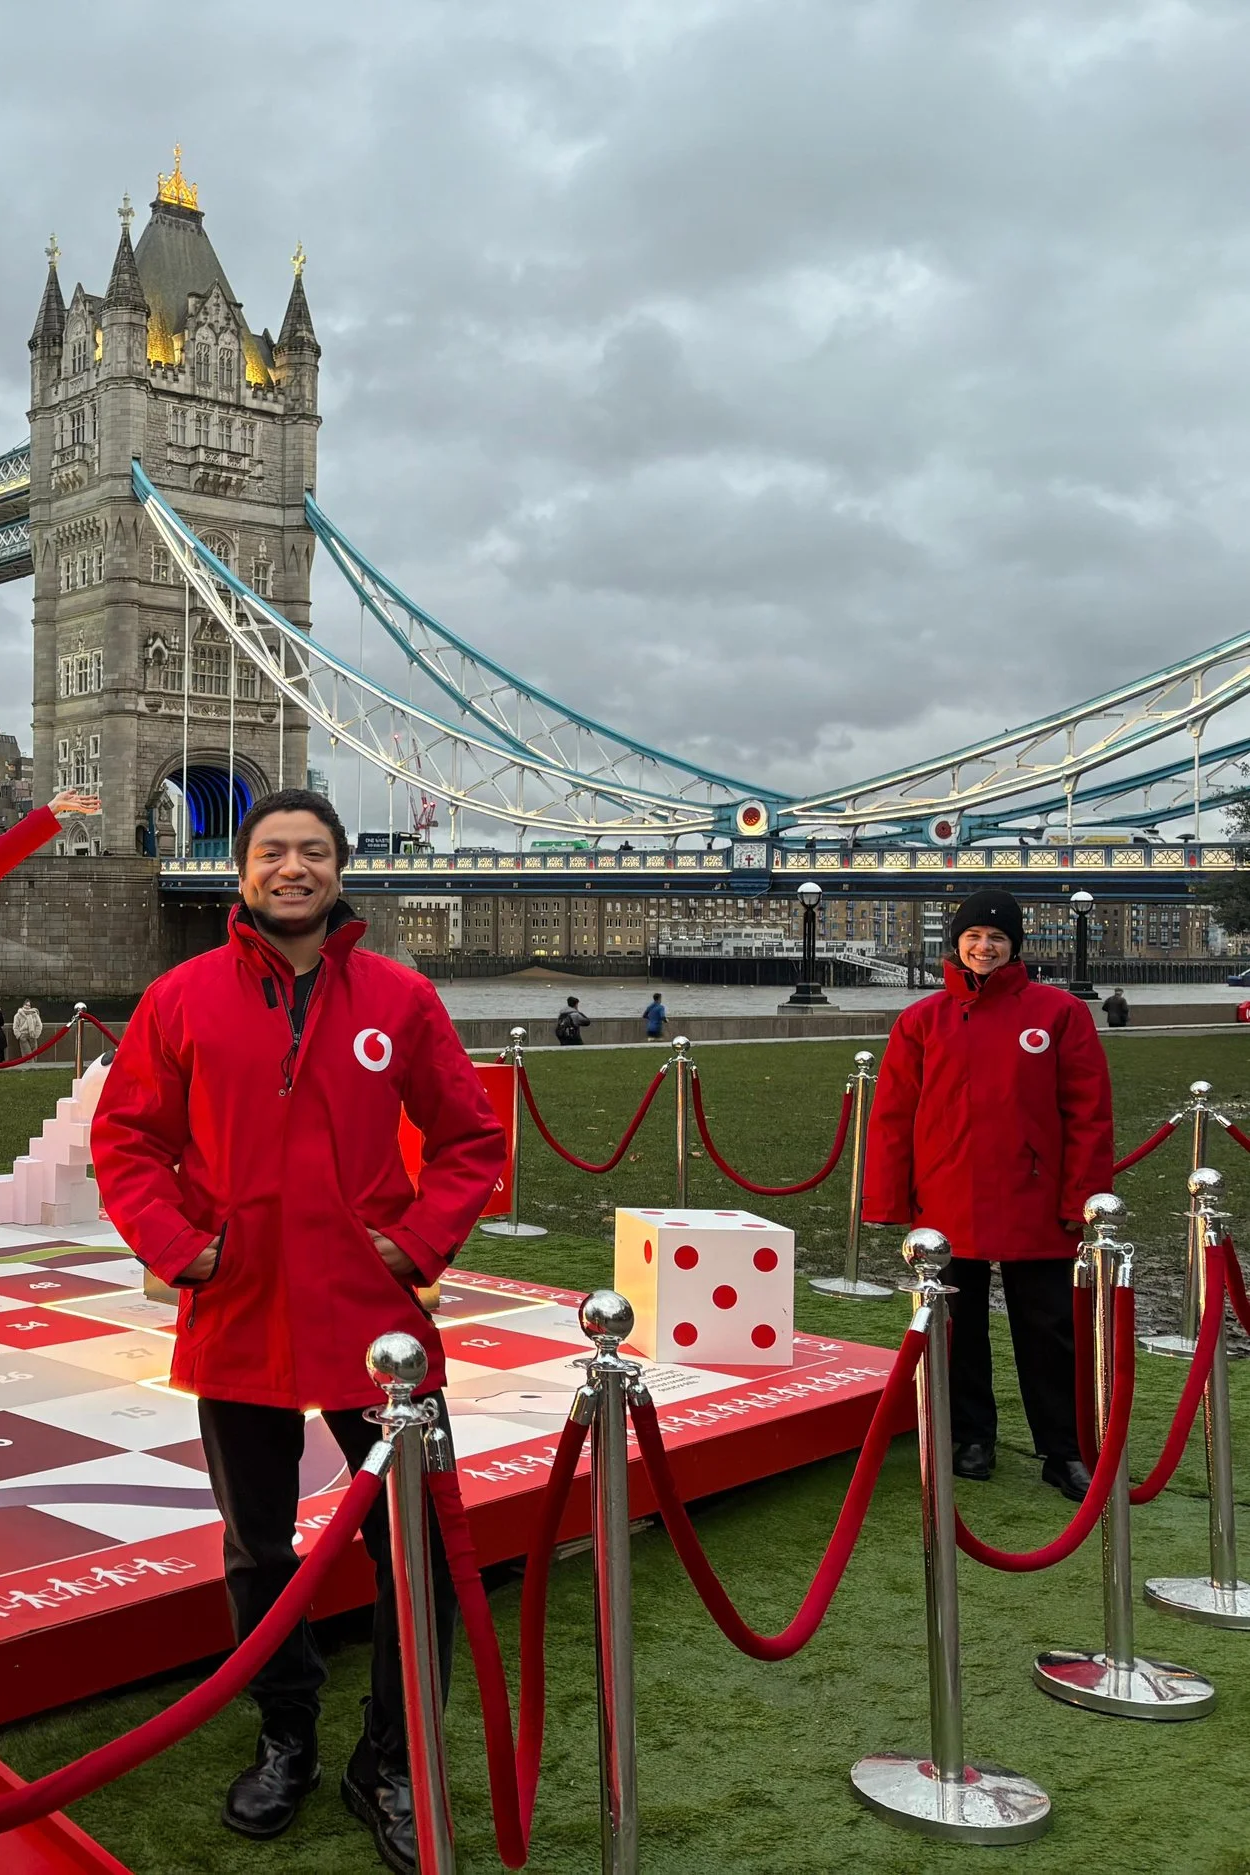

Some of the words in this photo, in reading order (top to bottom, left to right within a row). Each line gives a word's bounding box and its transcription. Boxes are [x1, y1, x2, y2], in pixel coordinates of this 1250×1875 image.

[29, 1281, 62, 1290] 48
[5, 1319, 50, 1332] 34
[461, 1337, 502, 1349] 12
[110, 1405, 157, 1421] 15
